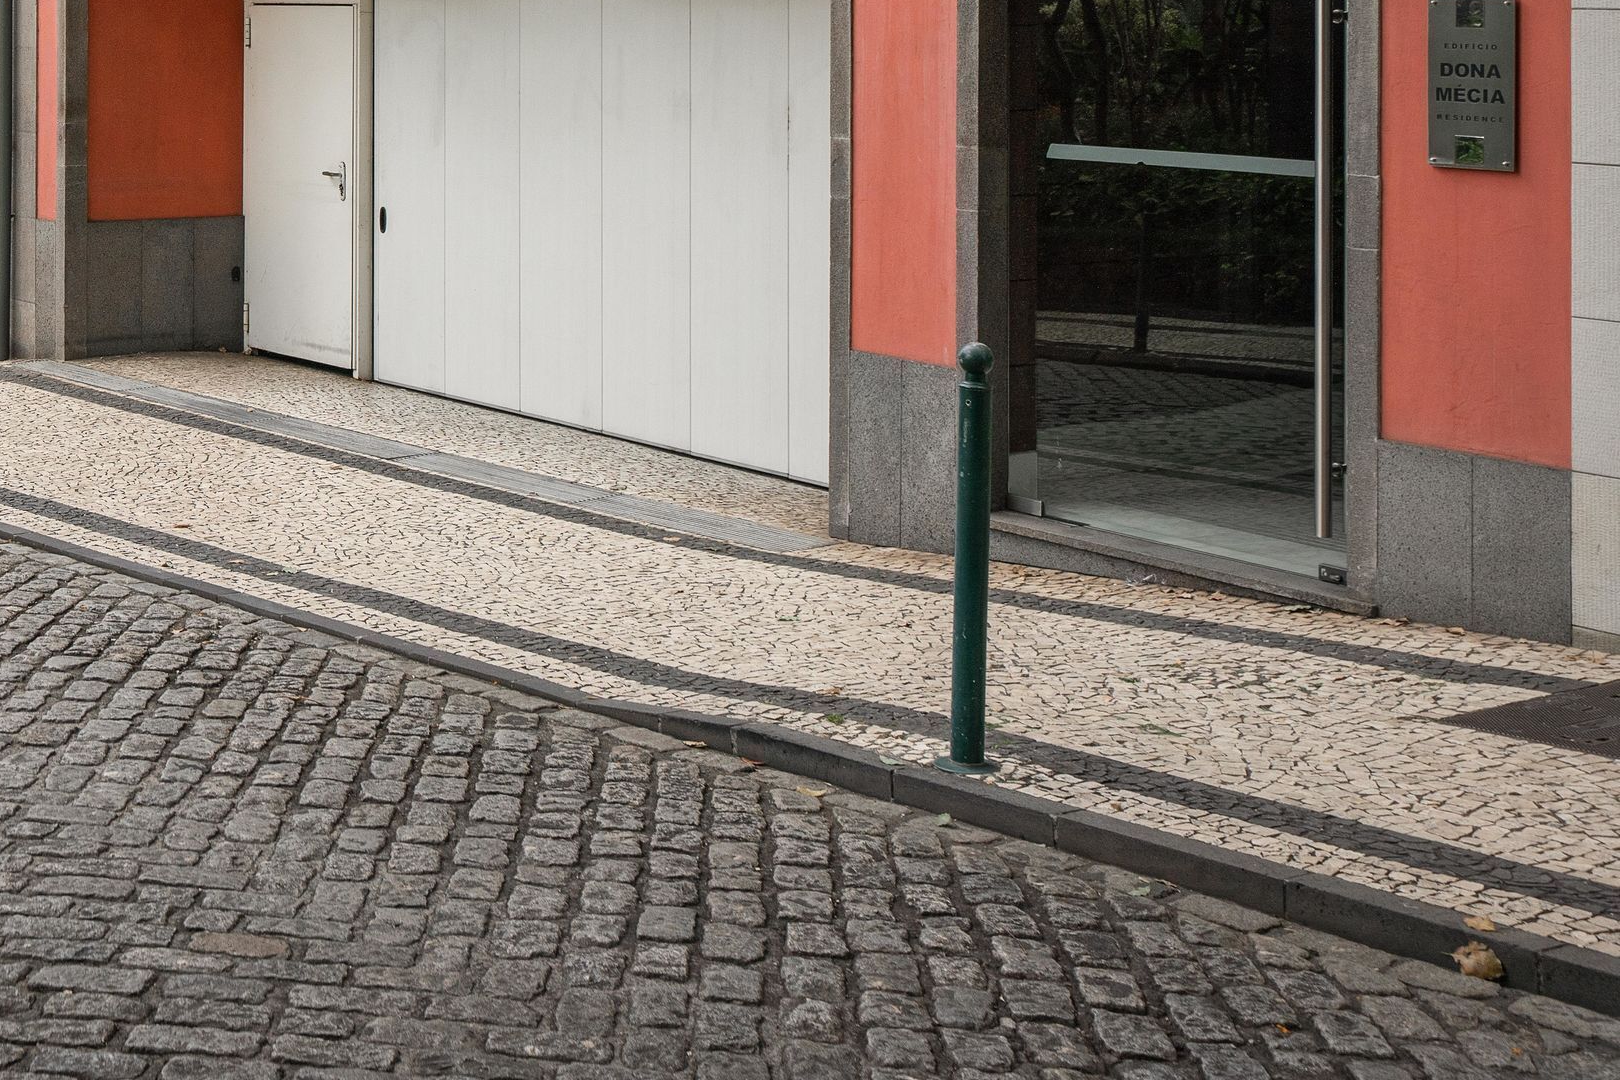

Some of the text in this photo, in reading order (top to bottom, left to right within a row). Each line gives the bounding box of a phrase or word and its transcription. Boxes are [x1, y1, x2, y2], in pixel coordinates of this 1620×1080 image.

[1440, 62, 1501, 78] DONA
[1435, 84, 1505, 104] MÉCIA
[1436, 114, 1504, 123] RESIDENCE
